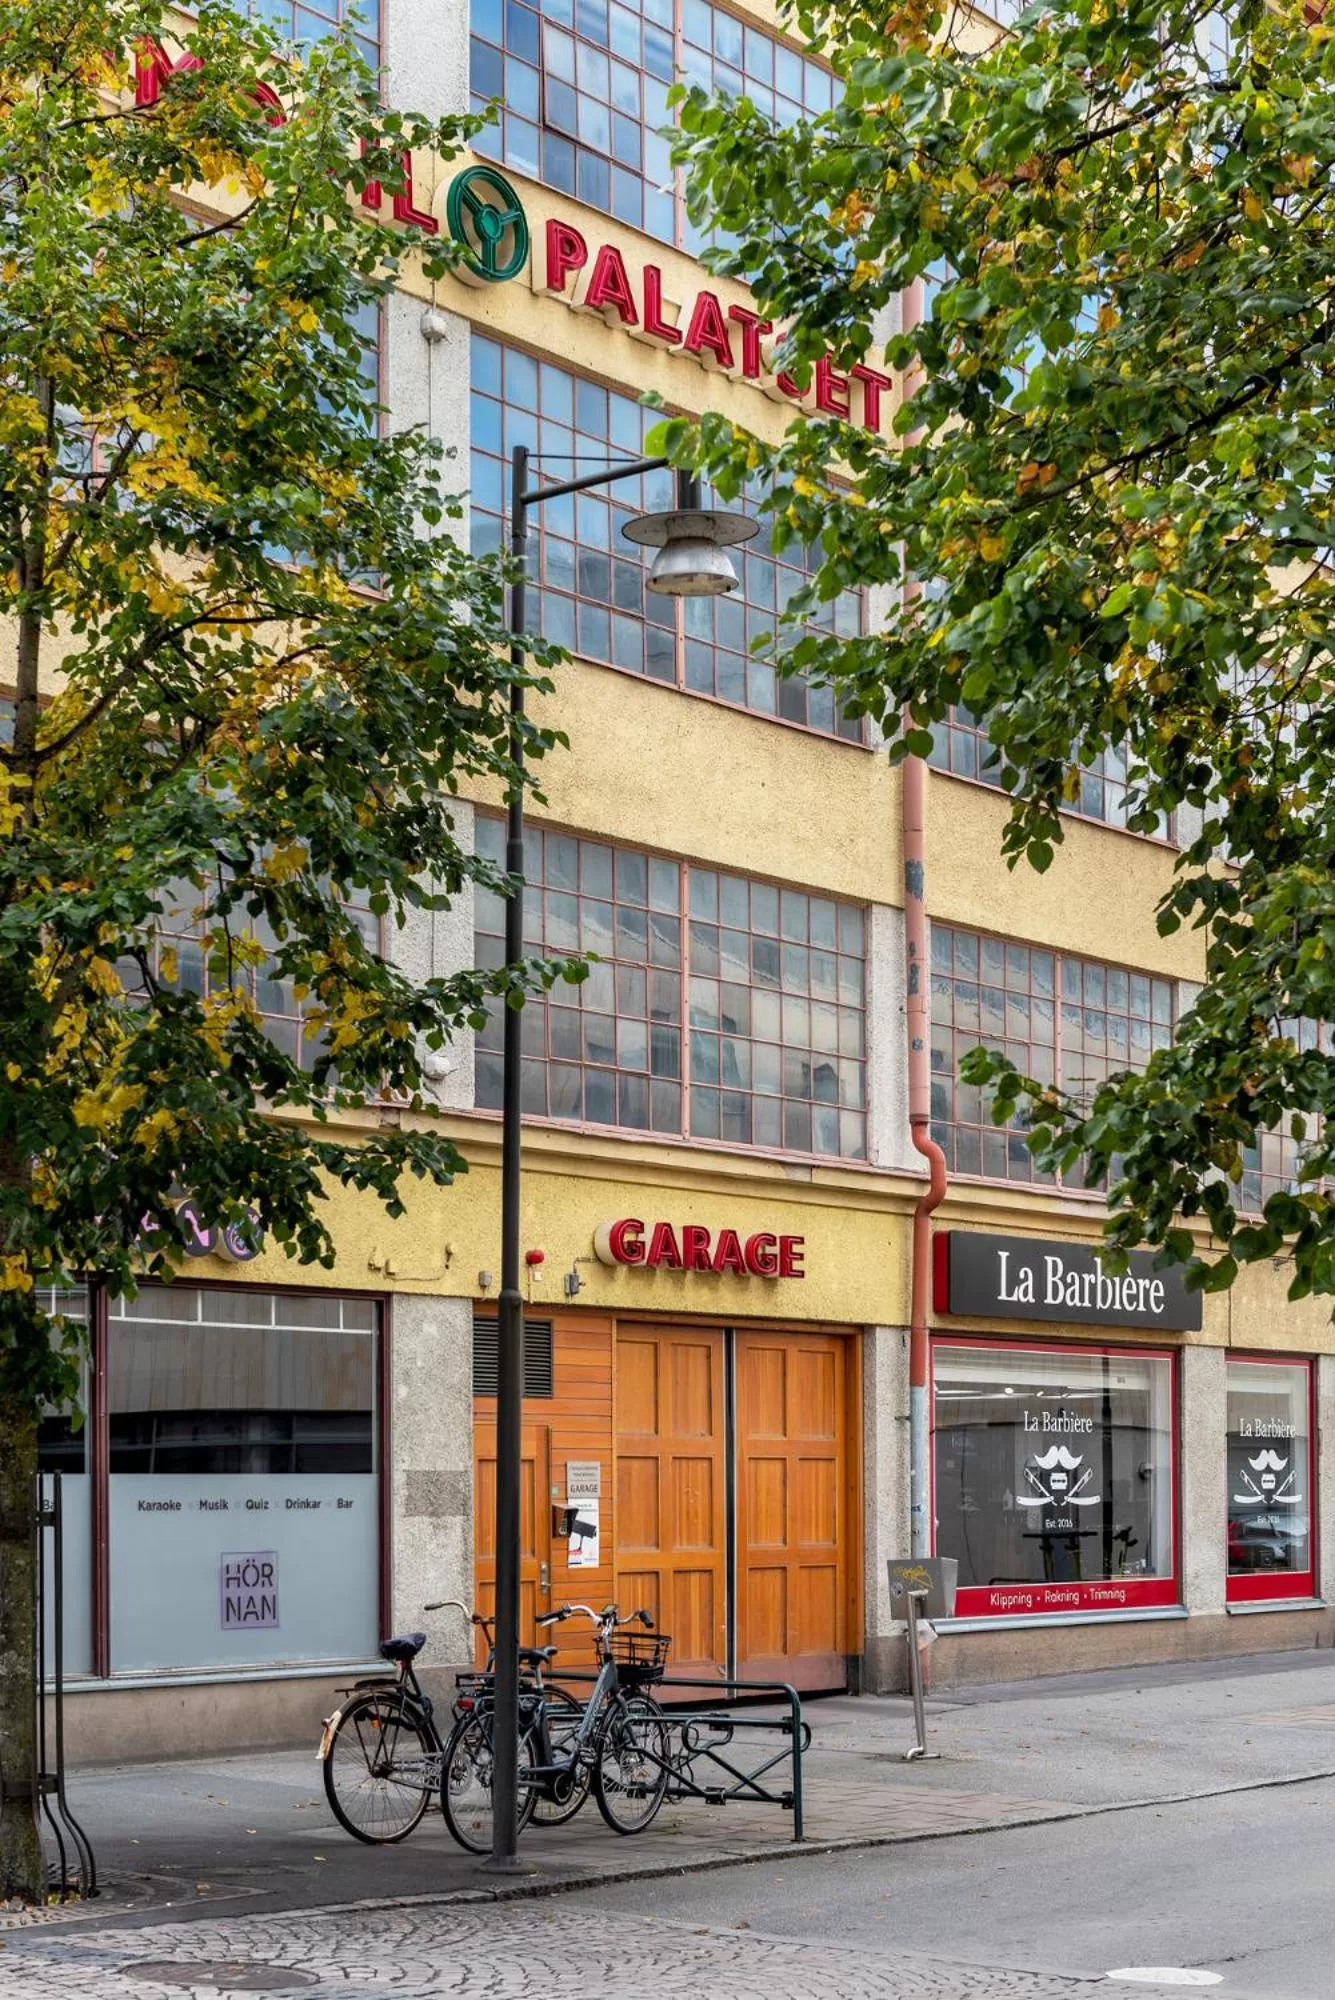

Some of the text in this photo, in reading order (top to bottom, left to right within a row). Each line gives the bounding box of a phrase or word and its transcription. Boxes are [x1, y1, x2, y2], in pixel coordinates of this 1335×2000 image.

[608, 1218, 805, 1278] GARAGE
[997, 1250, 1165, 1314] La Barbière
[1023, 1410, 1093, 1433] La Barbière
[1240, 1417, 1253, 1437] La
[570, 1483, 599, 1494] GARAGE
[138, 1498, 354, 1512] Karaoke Musik Quiz Drinkar Bar
[225, 1558, 274, 1589] HÖR
[225, 1594, 276, 1622] NAN
[990, 1587, 1126, 1609] Klippning Rakning Trimning
